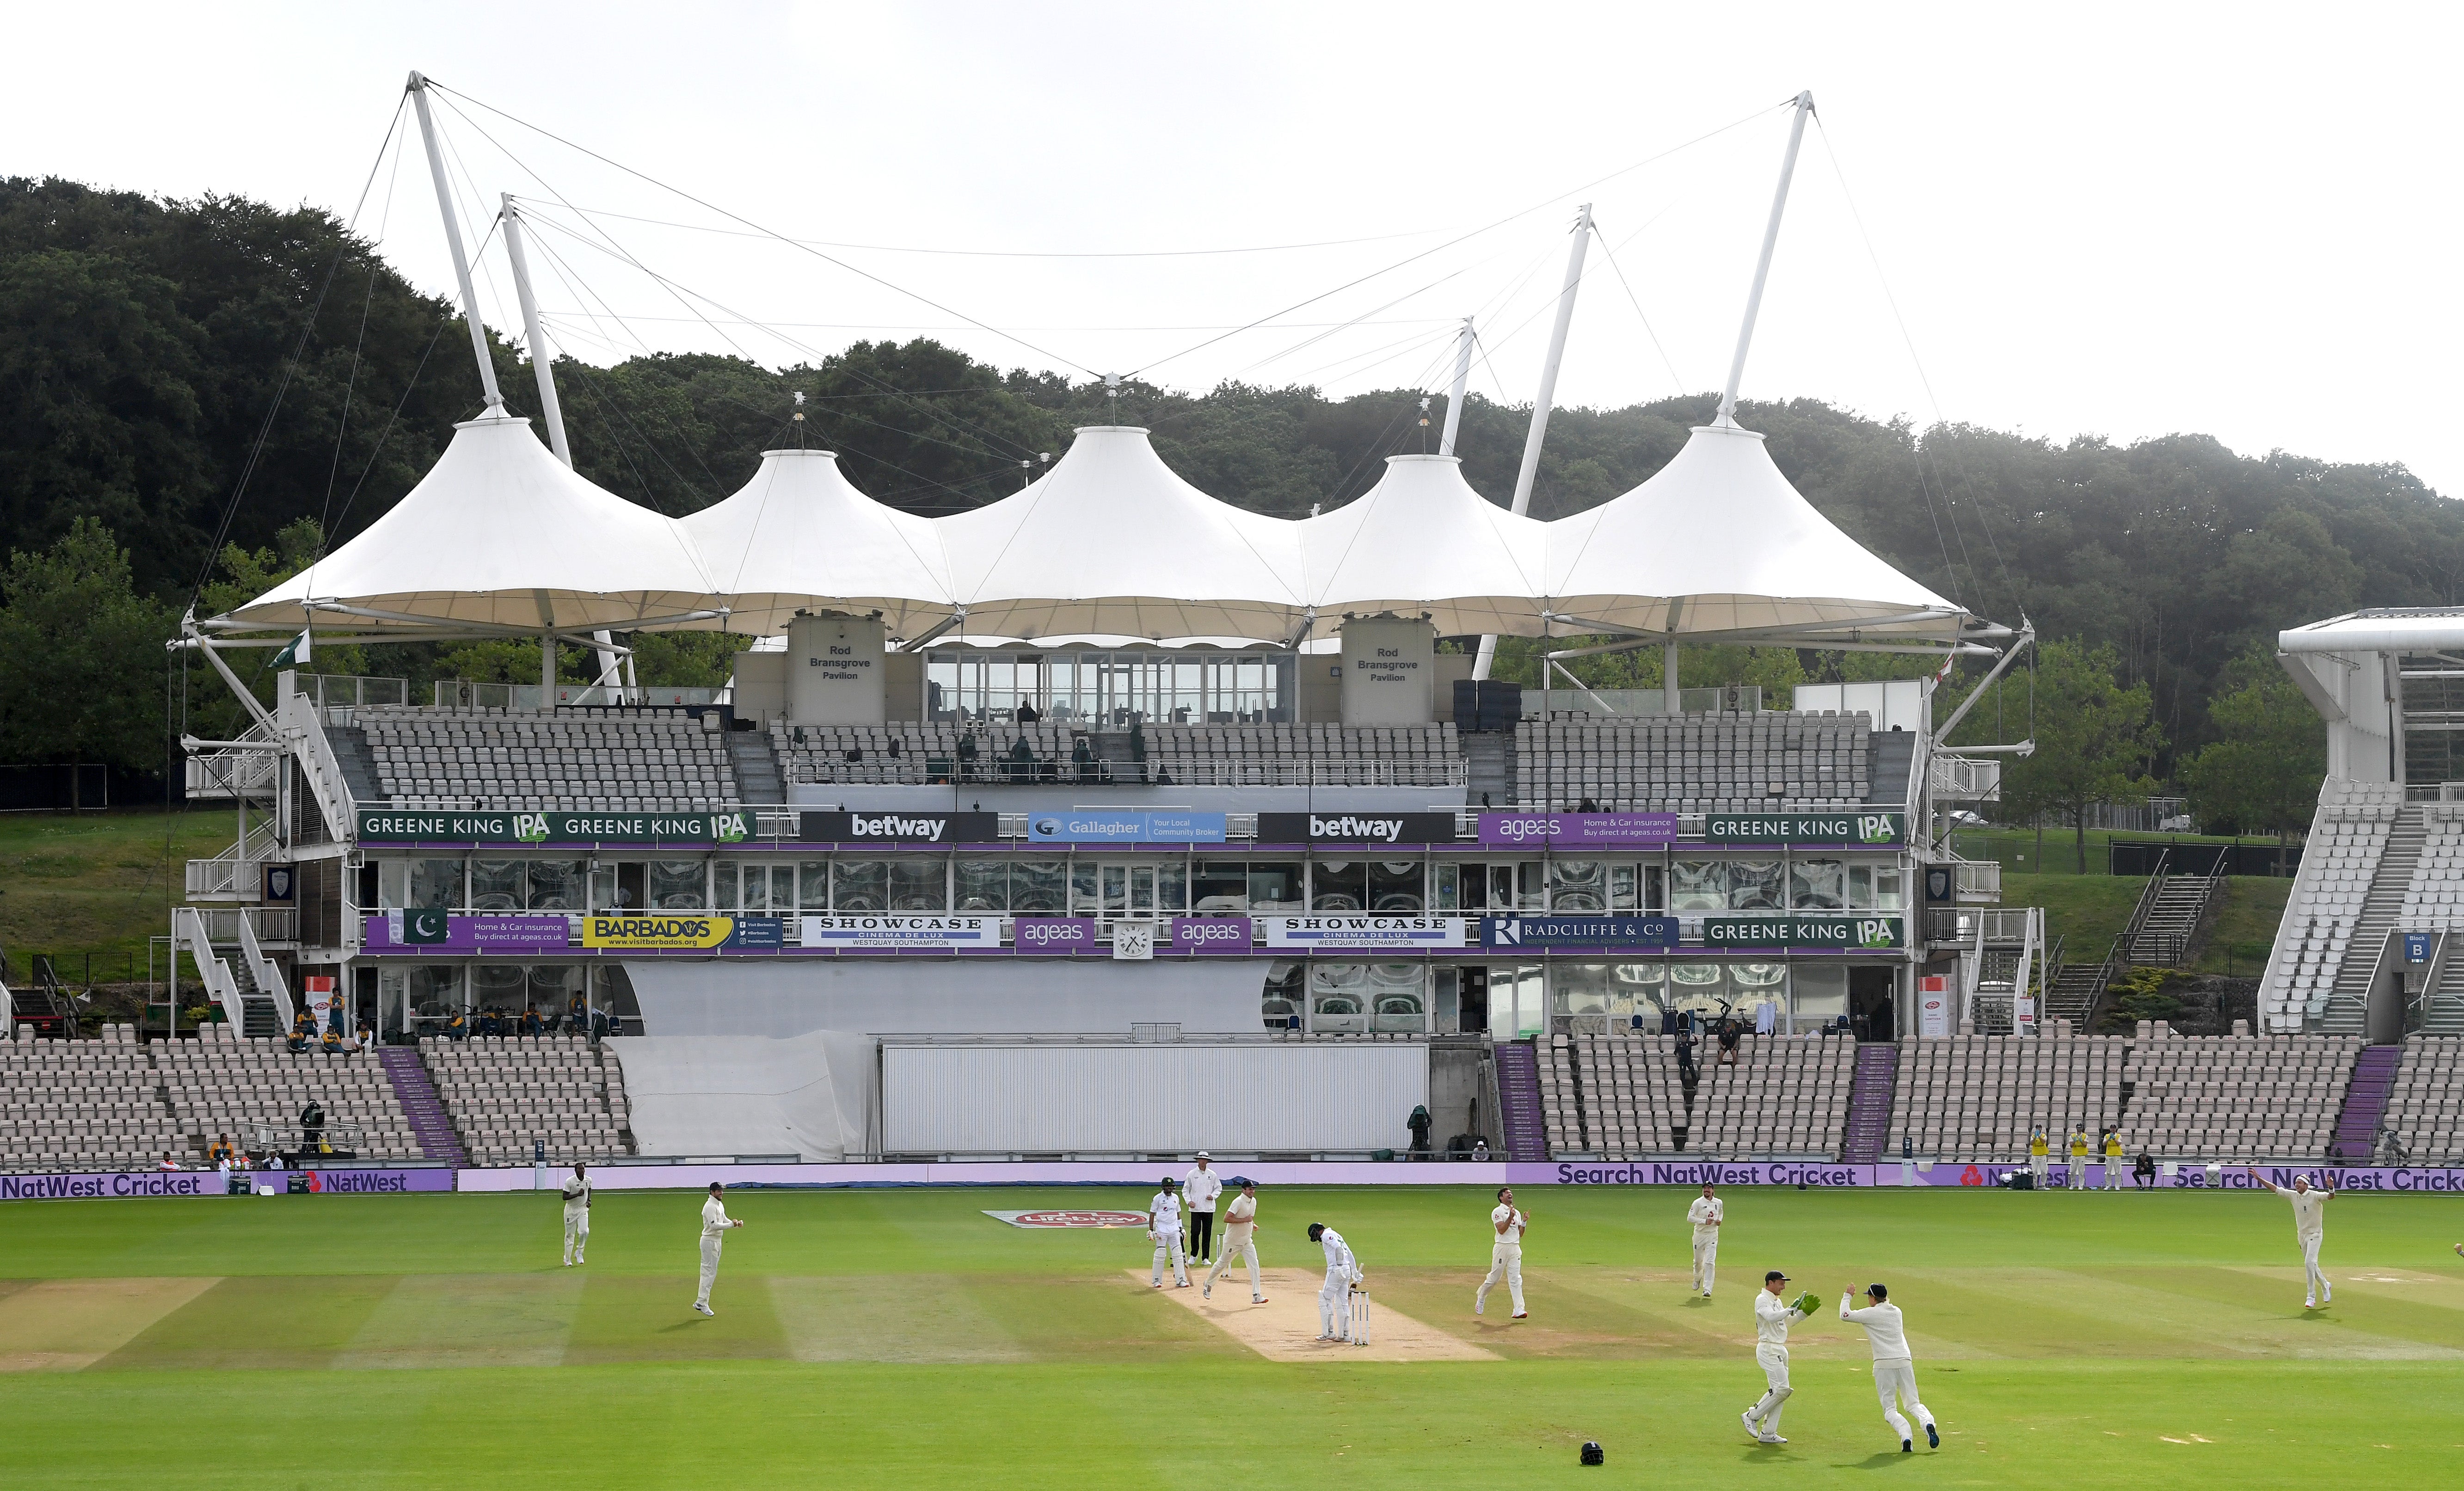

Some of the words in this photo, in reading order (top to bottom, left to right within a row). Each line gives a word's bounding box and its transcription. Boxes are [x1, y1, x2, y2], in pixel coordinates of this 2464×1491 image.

[830, 646, 850, 654] Rod
[1377, 648, 1398, 657] Rod
[810, 658, 870, 669] Bransgrove
[1358, 660, 1418, 671] Bransgrove
[366, 818, 444, 833] GREENE
[454, 819, 503, 833] KING
[512, 813, 550, 838] IPA
[565, 819, 643, 834] GREENE
[651, 819, 701, 834] KING
[709, 813, 748, 838] IPA
[852, 814, 946, 841] betway
[1069, 821, 1140, 835] Gallagher
[1309, 815, 1403, 842] betway
[1499, 819, 1561, 840] ageas
[1712, 820, 1789, 835] GREENE
[1798, 820, 1848, 835] KING
[1857, 814, 1895, 839] IPA
[595, 920, 710, 937] BARBADOS
[821, 918, 981, 929] SHOWCASE
[1286, 918, 1446, 929] SHOWCASE
[1524, 924, 1617, 936] RADCLIFFE
[1625, 924, 1636, 936] &
[1856, 919, 1894, 943] IPA
[474, 933, 490, 942] Buy
[521, 933, 562, 942] ageas.co.uk
[1025, 924, 1083, 945] ageas
[1181, 924, 1239, 945] ageas
[1711, 925, 1788, 939] GREENE
[1797, 925, 1847, 939] KING
[2413, 944, 2422, 955] B
[326, 1173, 407, 1192] NatWest
[1557, 1164, 1644, 1184] Search
[1653, 1164, 1759, 1184] NatWest
[1769, 1164, 1856, 1186] Cricket
[2392, 1169, 2464, 1190] Crick
[2, 1176, 104, 1199] NatWest
[113, 1174, 201, 1195] Cricket
[1025, 1214, 1138, 1225] Lifebuoy
